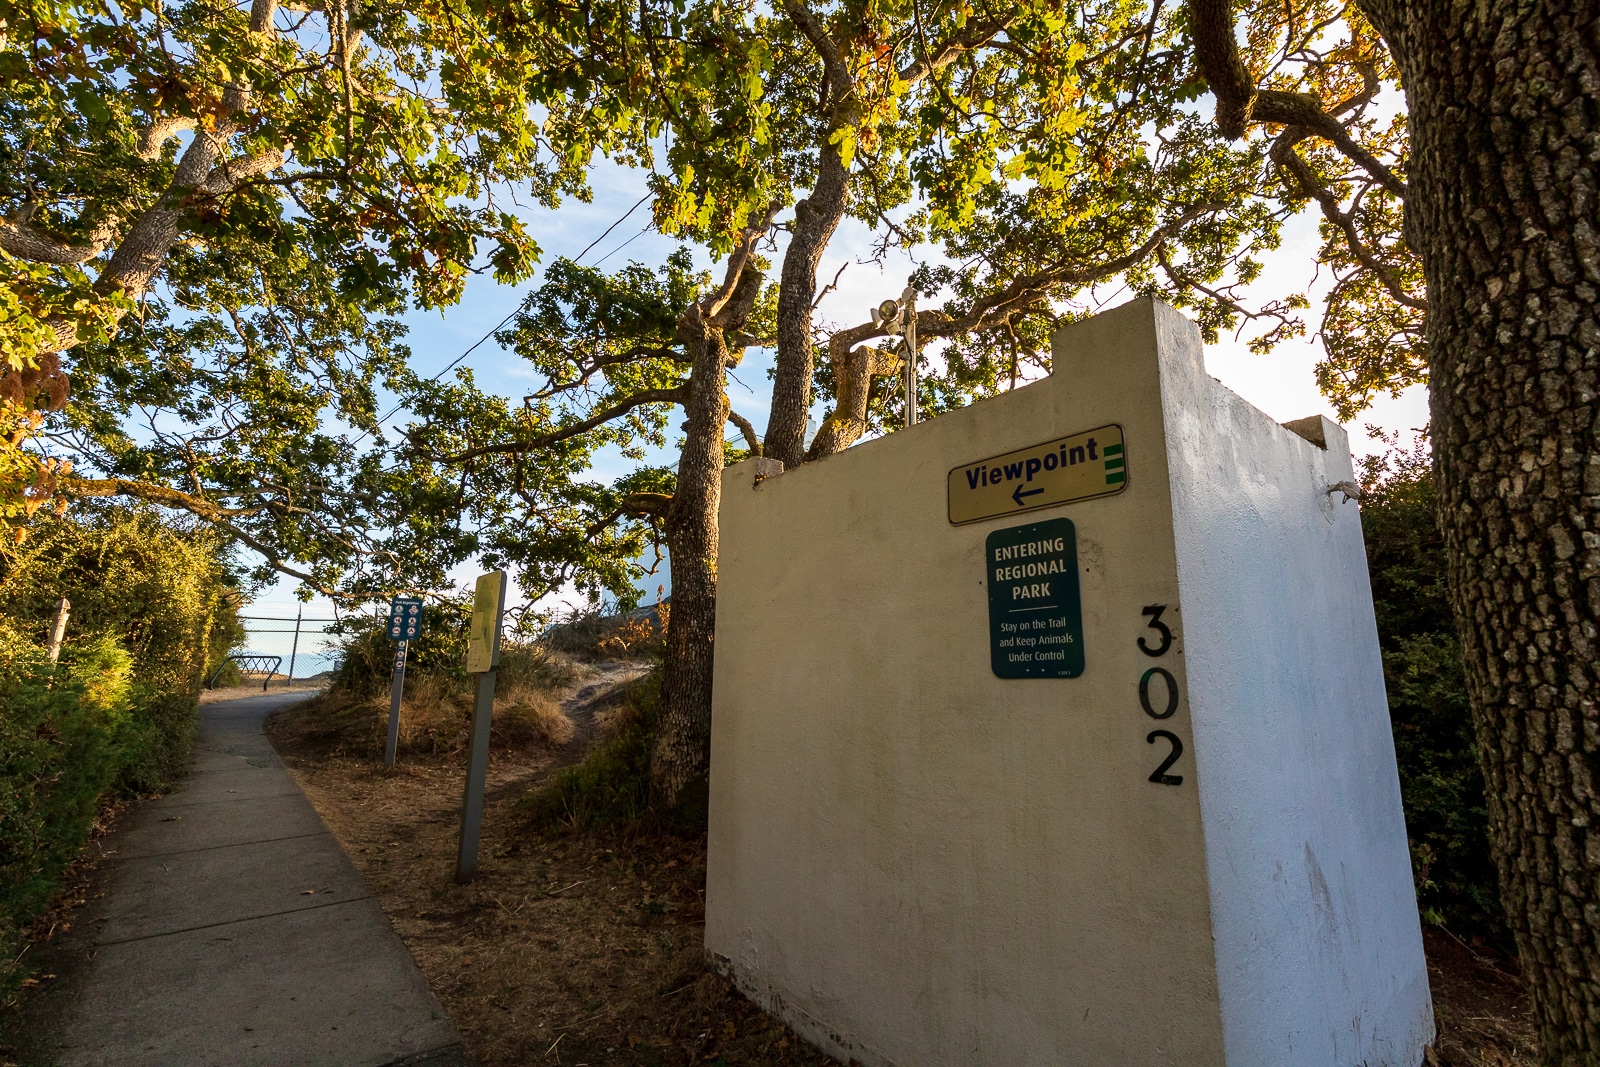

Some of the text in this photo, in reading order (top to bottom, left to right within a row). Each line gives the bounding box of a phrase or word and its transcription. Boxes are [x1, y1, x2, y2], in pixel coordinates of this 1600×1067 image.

[966, 438, 1098, 490] Viewpoint
[995, 537, 1064, 561] ENTERING
[996, 559, 1067, 581] REGIONAL
[1012, 582, 1051, 600] PARK
[1001, 617, 1066, 634] Stay on the Trail
[1000, 633, 1073, 648] and Keep Animals
[1009, 650, 1065, 662] Under Control
[1137, 605, 1183, 786] 302
